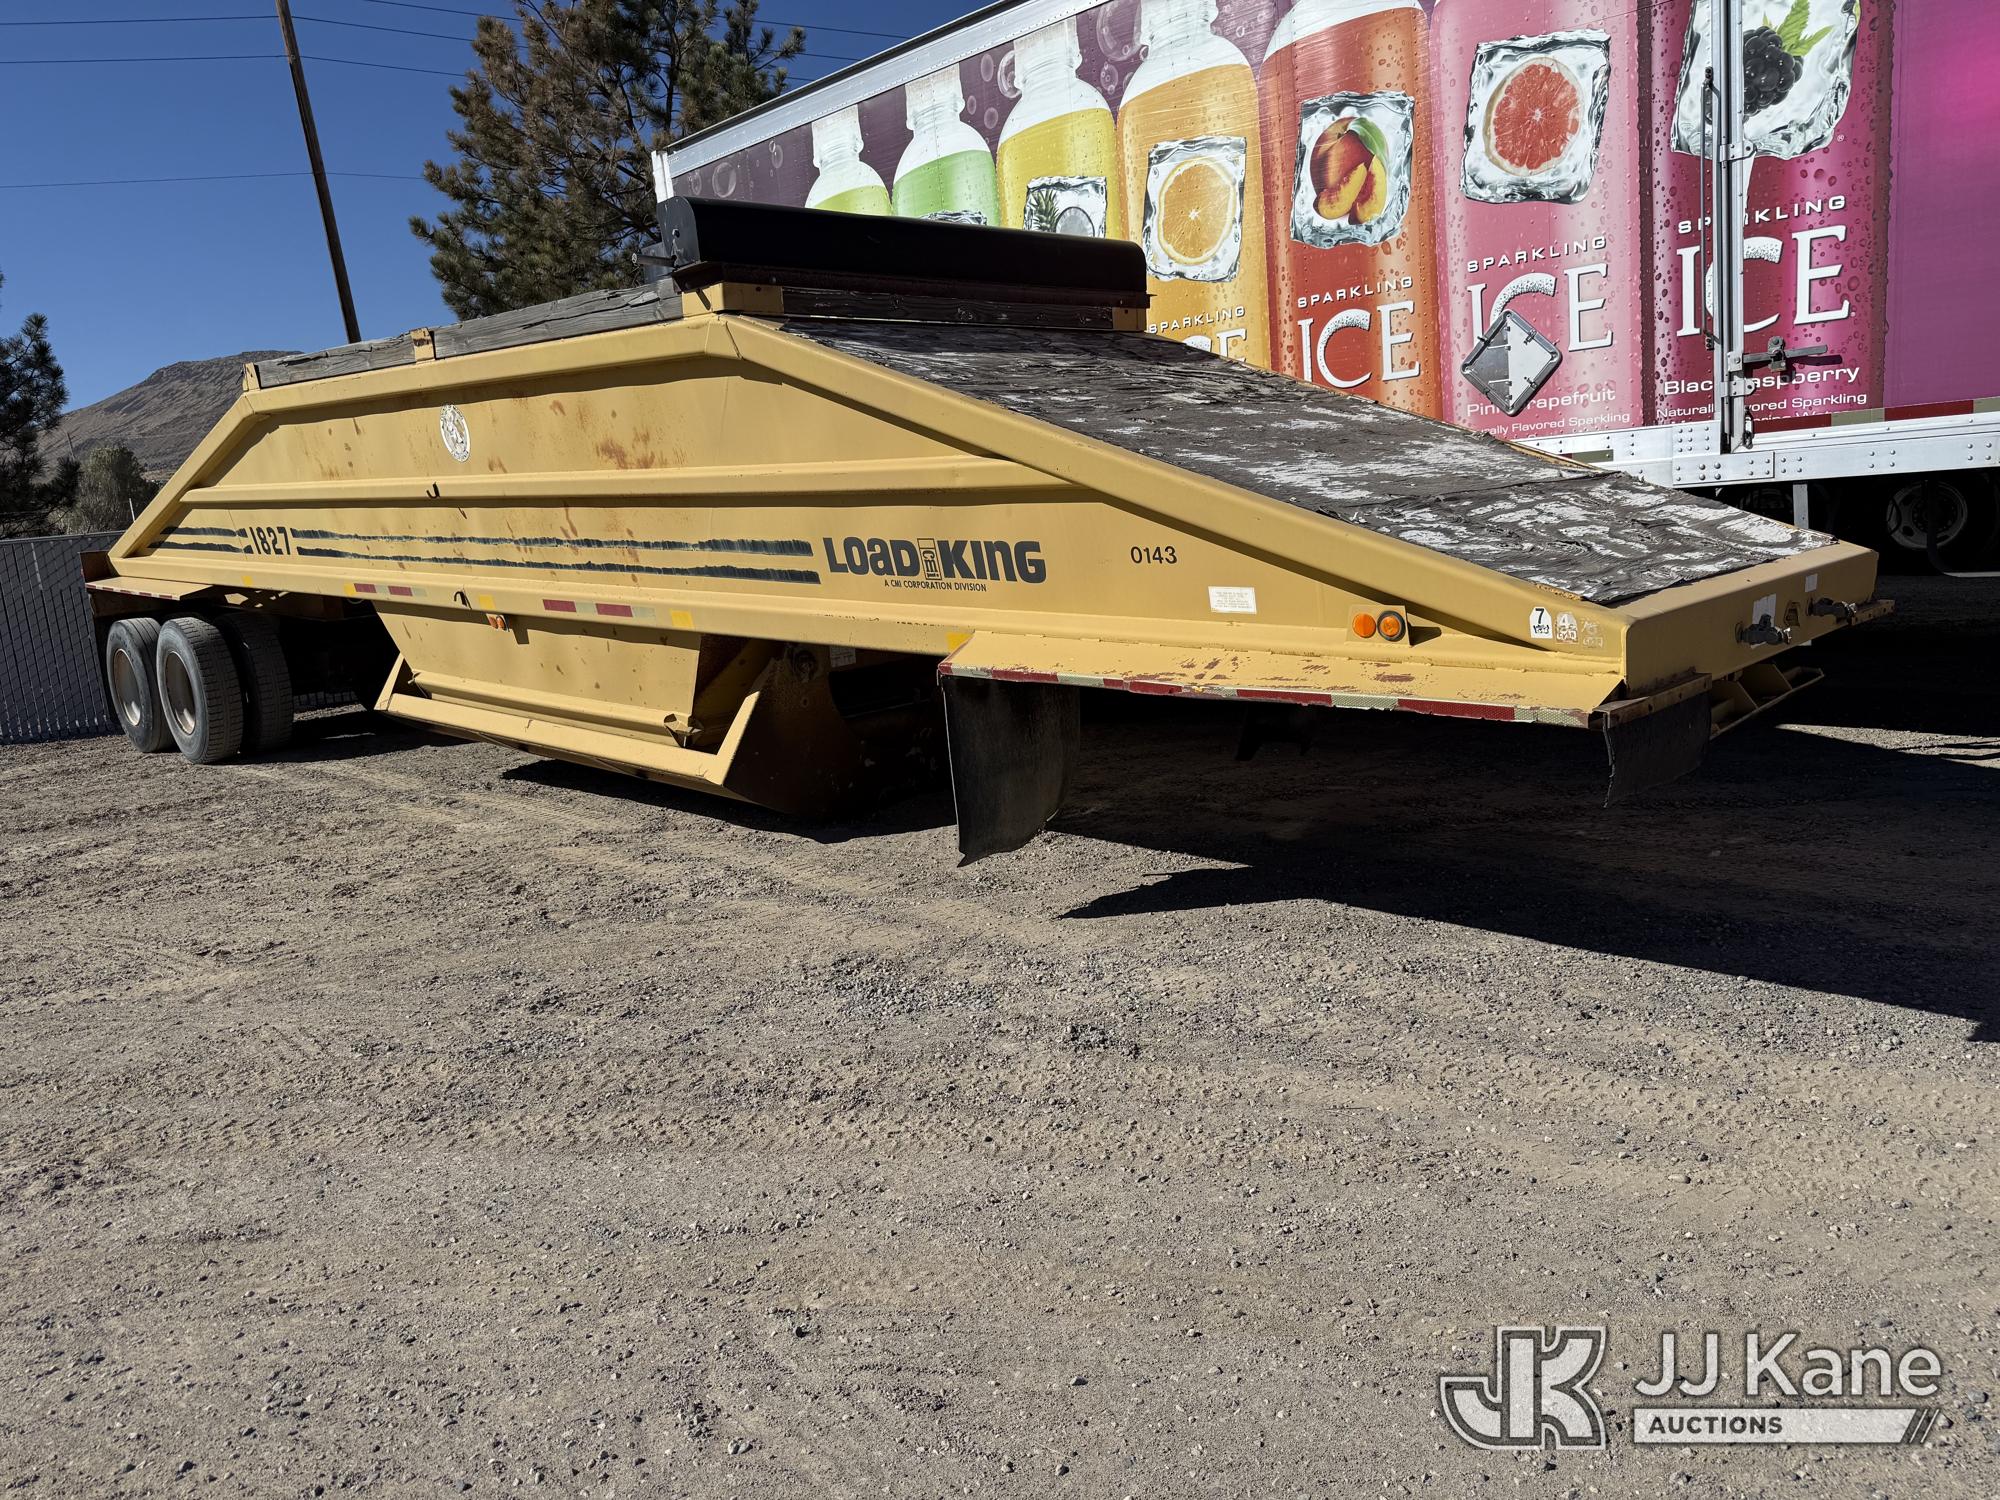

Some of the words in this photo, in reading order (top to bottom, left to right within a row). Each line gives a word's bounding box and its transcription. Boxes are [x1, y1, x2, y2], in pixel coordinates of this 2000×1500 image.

[1678, 195, 1845, 234] SPKLING
[1467, 236, 1607, 273] SPARKLING
[1297, 276, 1413, 309] SPARKLING
[1149, 306, 1245, 334] SPARKLING
[1297, 300, 1420, 389] ICE
[1664, 379, 1713, 395] Blac
[1752, 367, 1860, 390] aspberry
[1467, 402, 1500, 417] Pin
[1527, 388, 1616, 410] rapefruit
[1656, 403, 1714, 418] Naturall
[1791, 393, 1867, 409] Sparkling
[1511, 418, 1565, 433] Flavored
[1568, 412, 1630, 427] Sparkling
[249, 526, 292, 556] 1827
[1130, 545, 1178, 565] 0143
[884, 579, 890, 588] A
[903, 580, 953, 591] CORPORATION
[954, 581, 987, 592] DIVISION
[1535, 608, 1545, 624] 7
